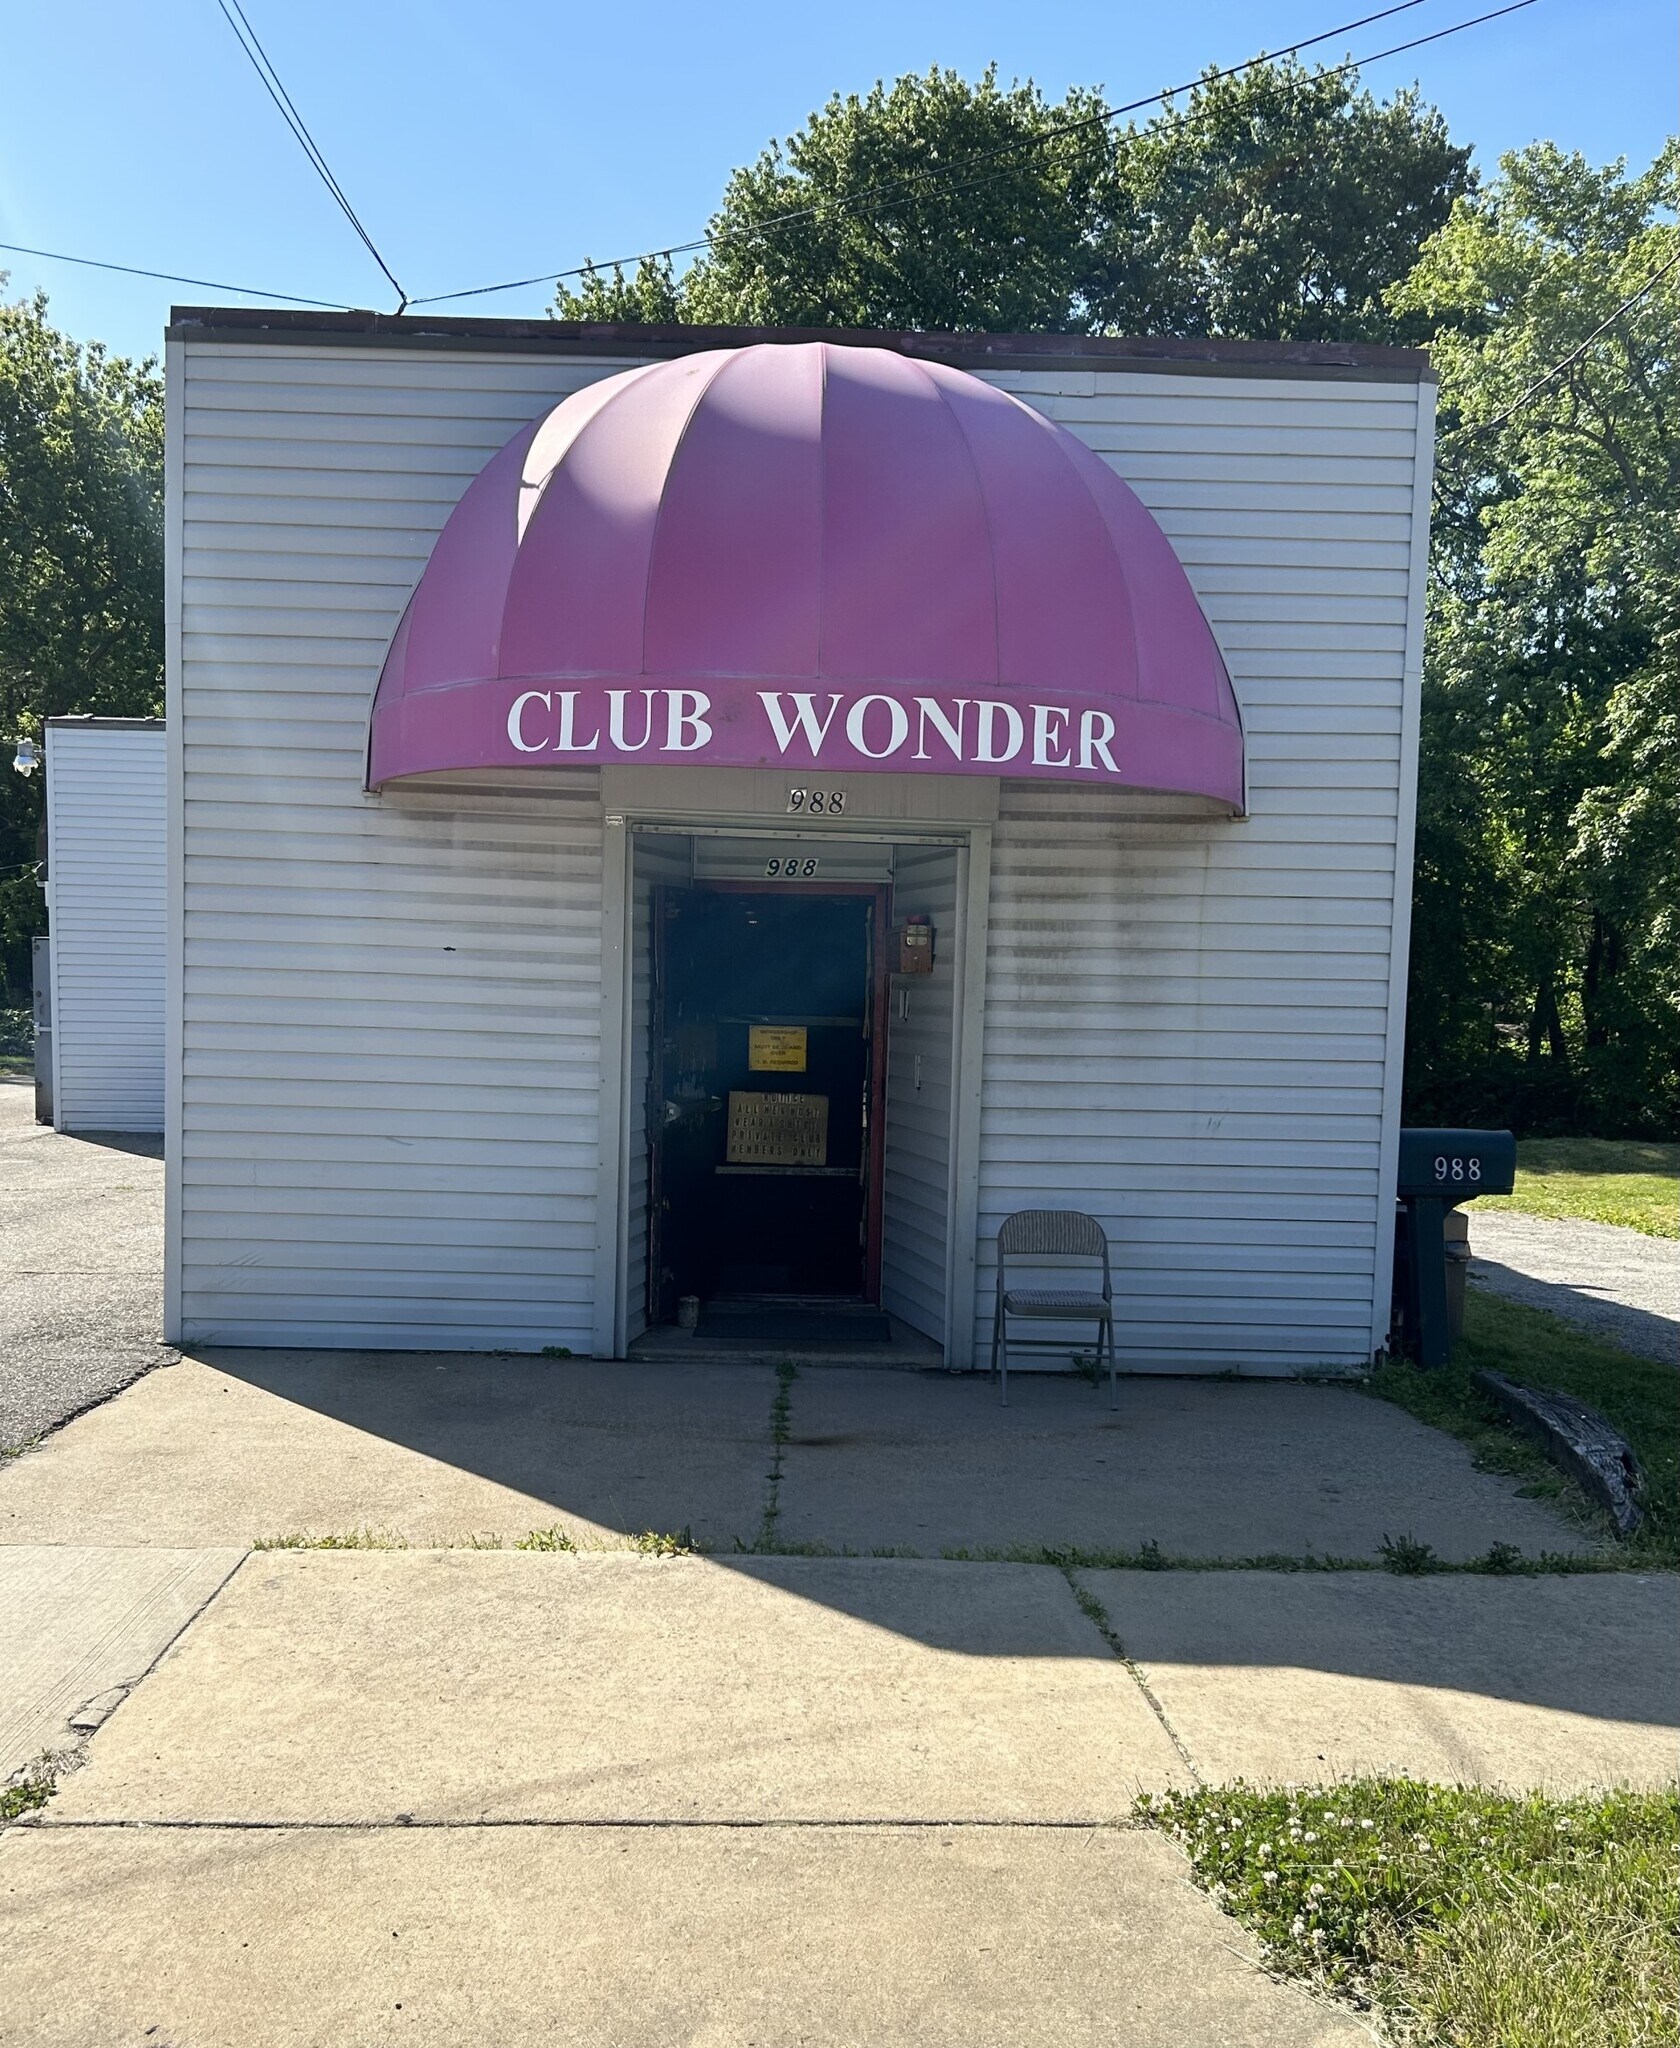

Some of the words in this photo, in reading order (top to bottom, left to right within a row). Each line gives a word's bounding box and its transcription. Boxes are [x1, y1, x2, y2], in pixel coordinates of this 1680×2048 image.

[507, 689, 714, 753] CLUB
[756, 691, 1122, 773] WONDER
[789, 790, 844, 814] 988
[766, 859, 817, 877] 988
[737, 1103, 759, 1115] ALL
[764, 1104, 786, 1116] MEN
[789, 1106, 820, 1118] MUST
[735, 1117, 764, 1128] WEAR
[769, 1118, 775, 1128] A
[732, 1130, 785, 1142] PRIVATE
[793, 1133, 821, 1145] CLUB
[731, 1143, 783, 1156] MEMBERS
[792, 1146, 821, 1158] ONLY
[1434, 1156, 1482, 1181] 988
